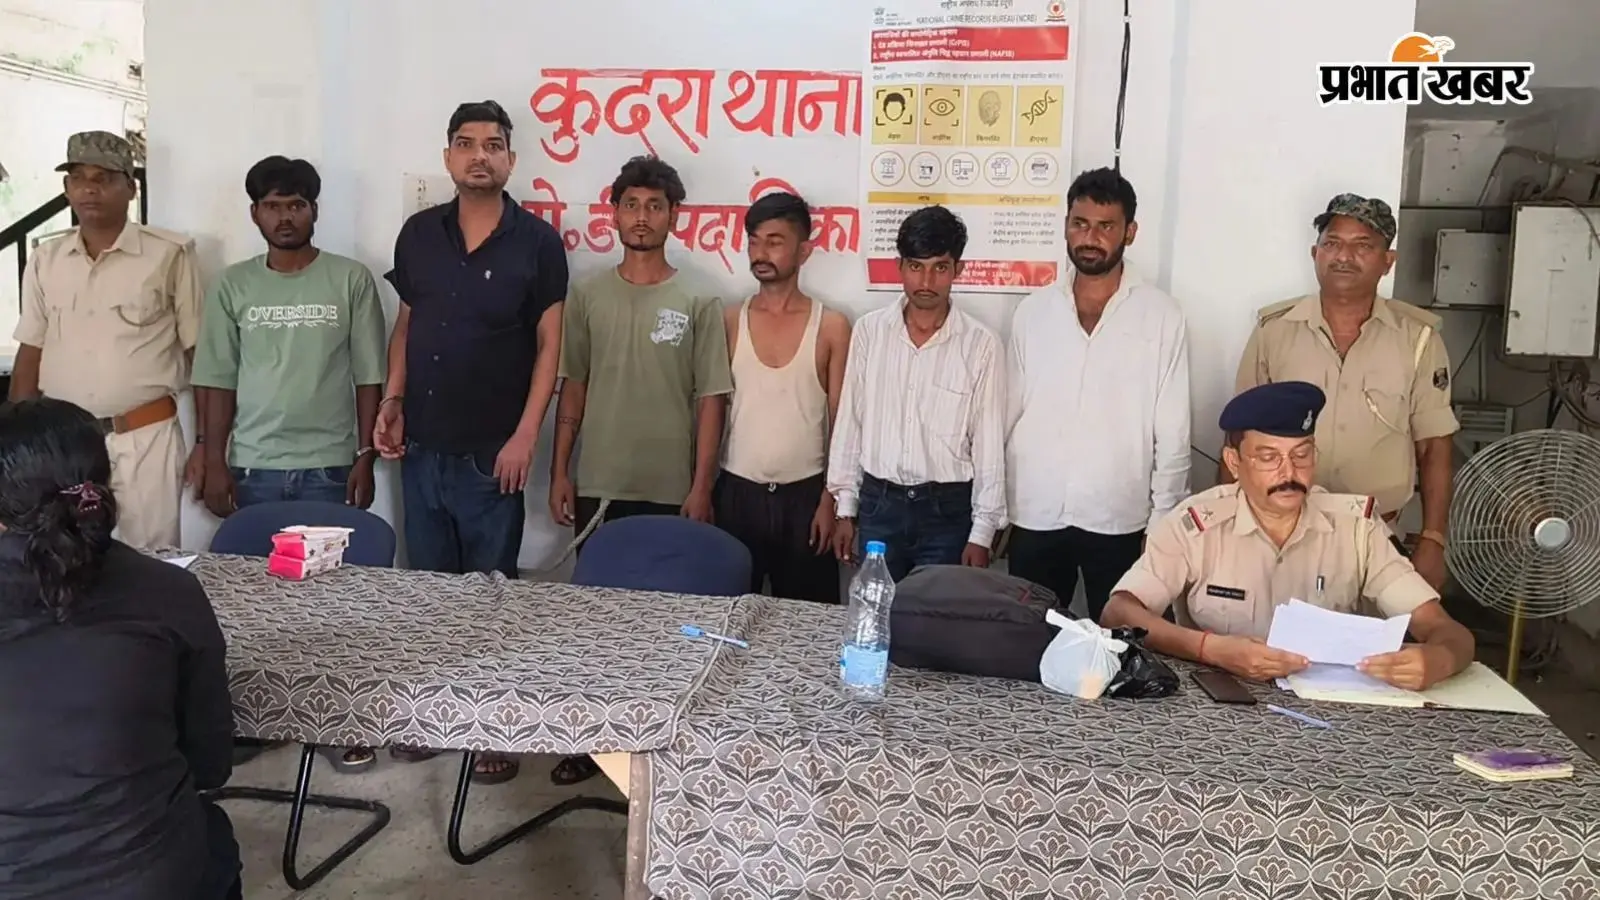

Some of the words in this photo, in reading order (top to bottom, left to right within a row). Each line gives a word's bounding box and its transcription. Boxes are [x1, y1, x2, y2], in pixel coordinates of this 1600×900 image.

[917, 16, 945, 24] NATIONAL
[946, 14, 965, 23] CRIME
[965, 14, 990, 23] RECORDS
[992, 14, 1015, 23] BUREAU
[530, 69, 716, 163] कुदरा
[722, 69, 863, 137] थाना
[247, 304, 338, 322] OVERSIDE
